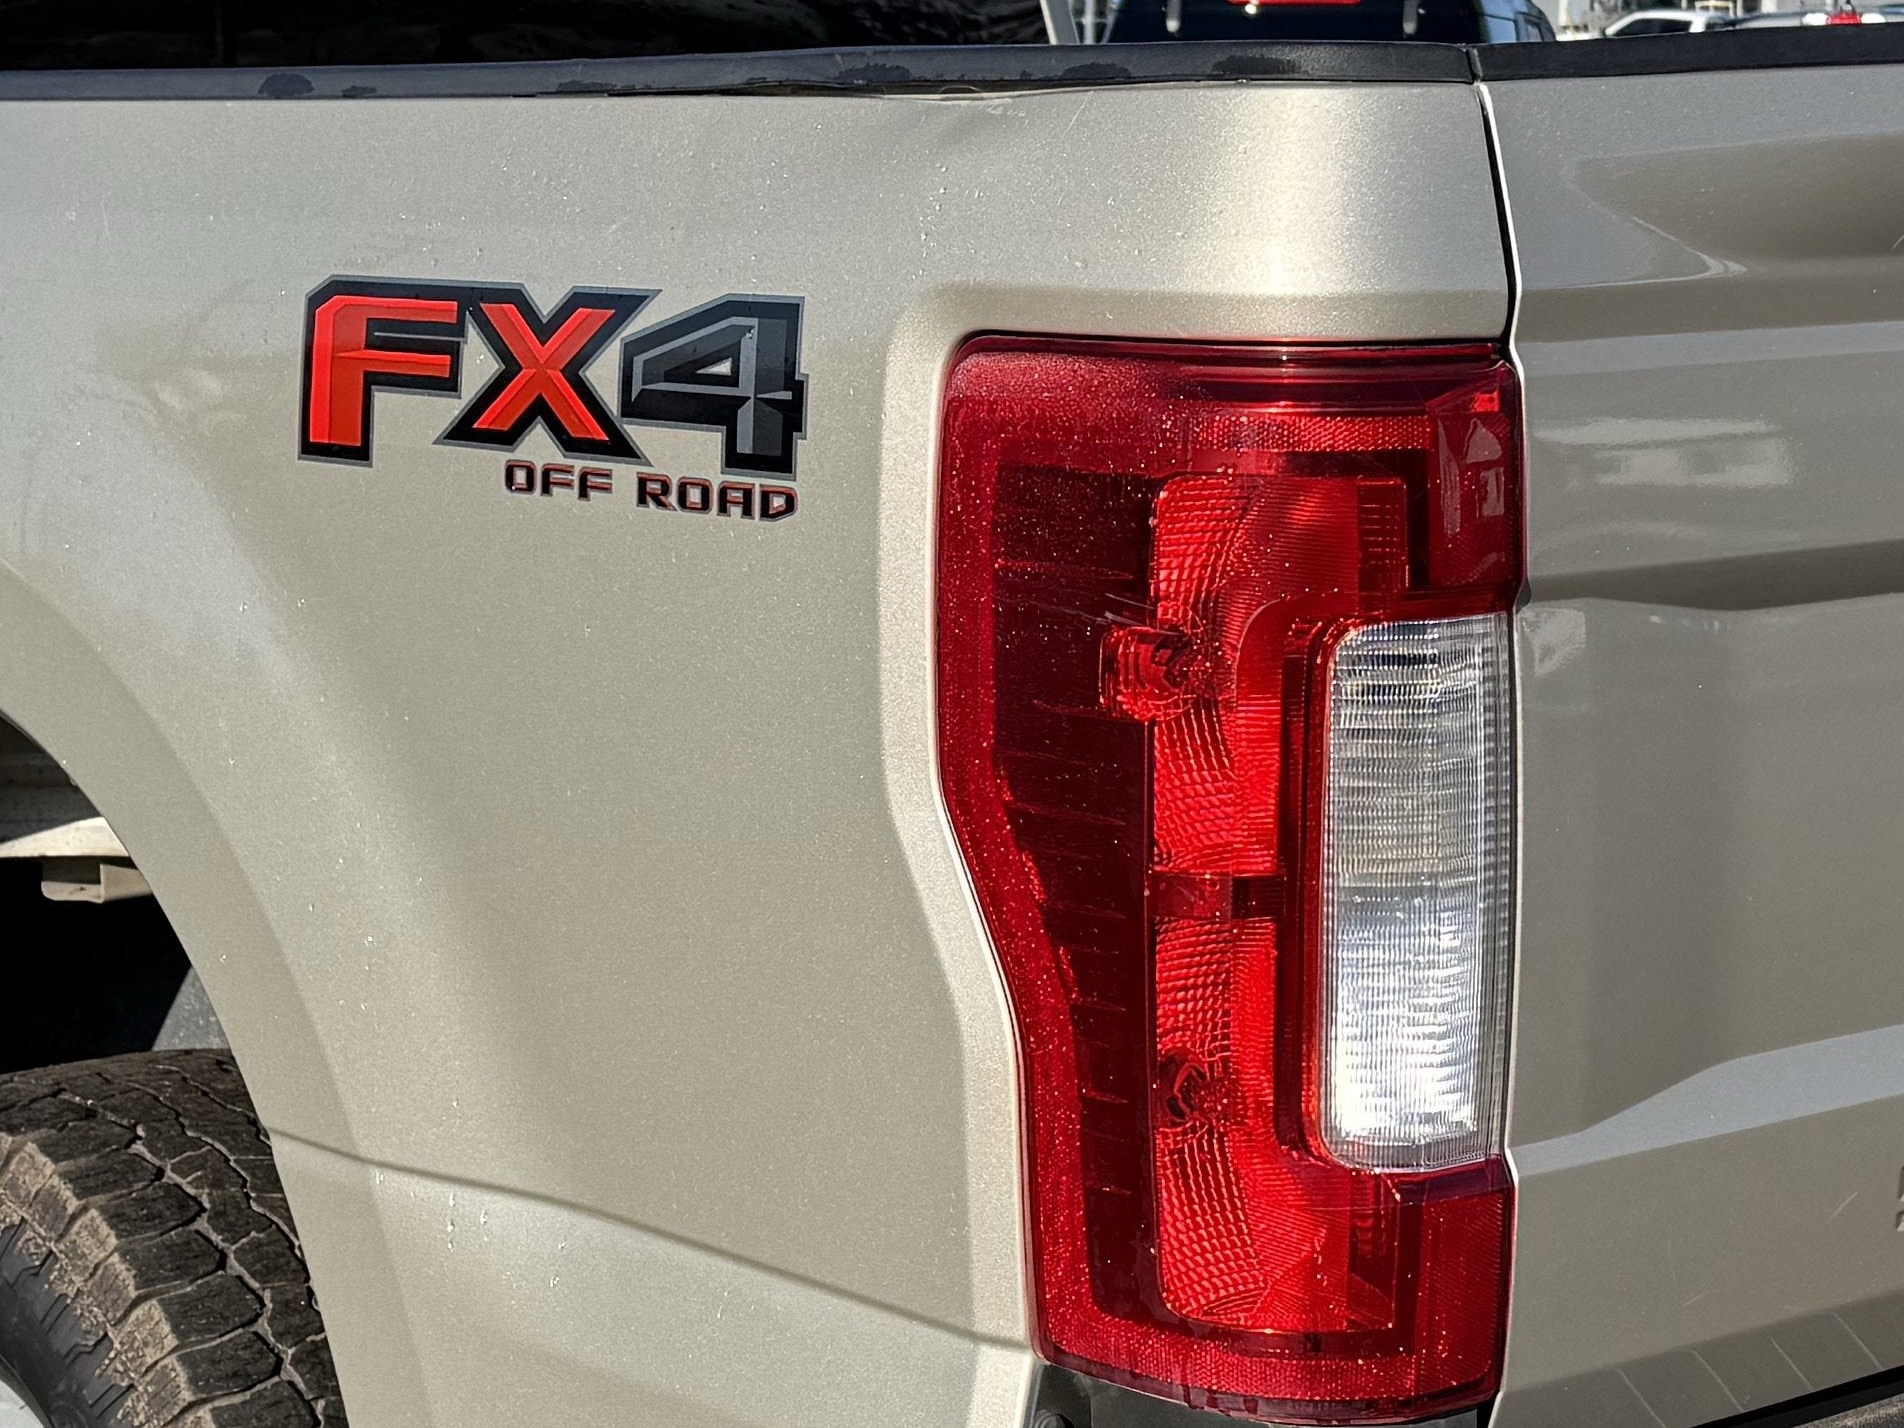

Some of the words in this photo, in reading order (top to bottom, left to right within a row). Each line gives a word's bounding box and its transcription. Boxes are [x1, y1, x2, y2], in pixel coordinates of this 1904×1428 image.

[297, 274, 808, 481] FX4
[504, 459, 614, 502] OFF
[635, 471, 798, 523] ROAD
